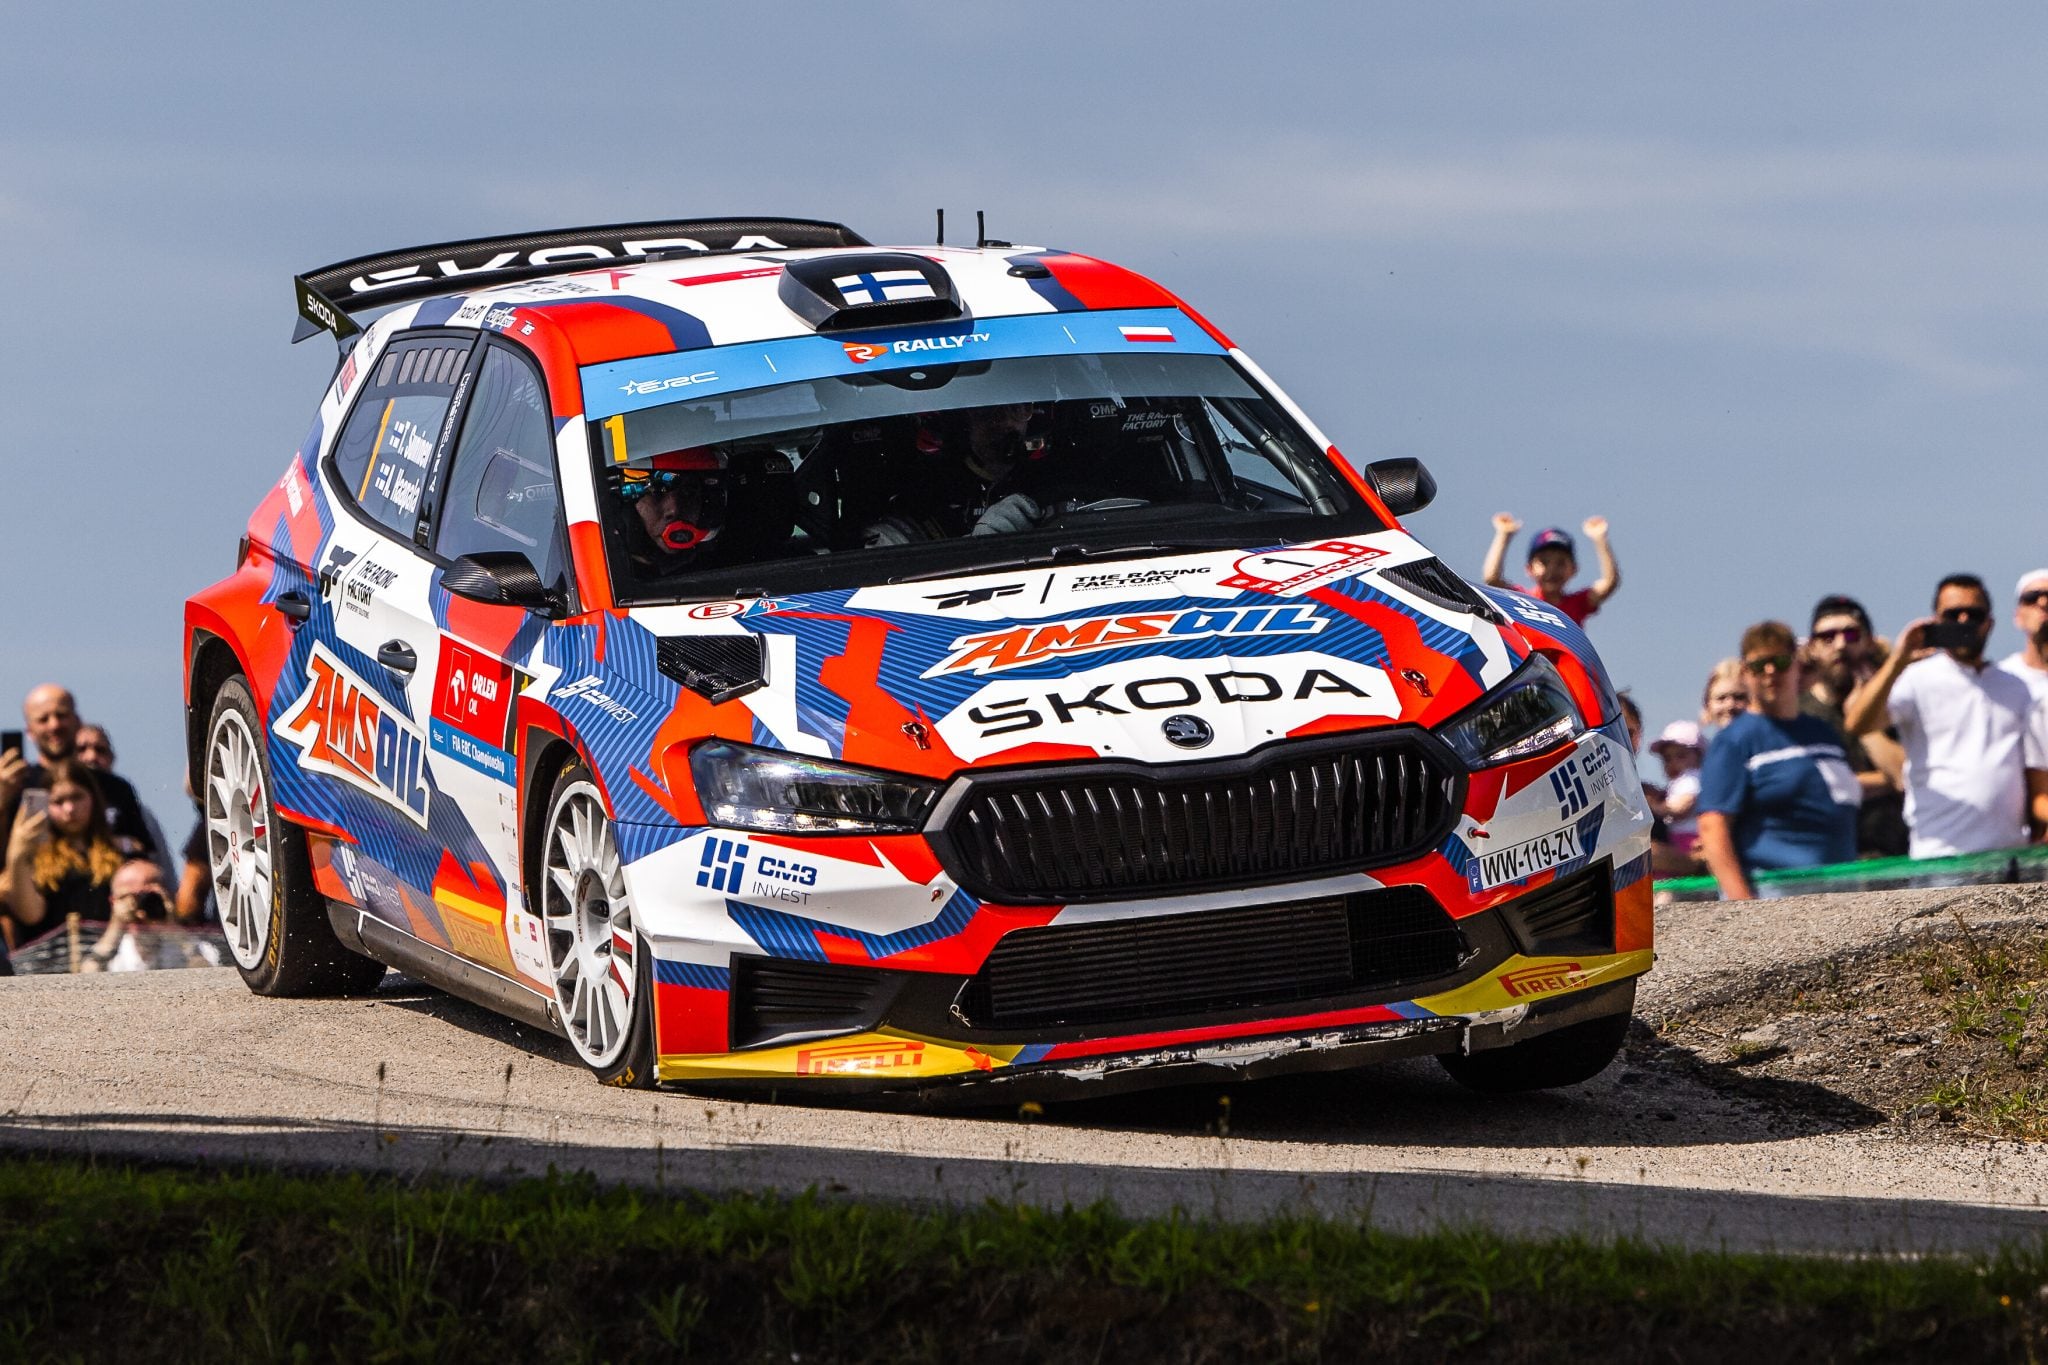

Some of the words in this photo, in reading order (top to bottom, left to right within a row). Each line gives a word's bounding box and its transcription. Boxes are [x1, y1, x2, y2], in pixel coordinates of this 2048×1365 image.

[307, 294, 338, 332] SKODA
[893, 335, 968, 353] RALLY
[637, 371, 719, 394] ERC
[1090, 404, 1117, 416] OMP
[1127, 413, 1146, 422] THE
[604, 414, 628, 463] 1
[1121, 419, 1167, 431] FACTORY
[357, 560, 378, 579] THE
[368, 566, 398, 589] RACING
[1075, 573, 1120, 583] THE
[1127, 567, 1211, 579] RACING
[1262, 557, 1315, 568] 1
[1268, 571, 1320, 592] RALLY
[1319, 551, 1381, 574] POLAND
[347, 579, 375, 606] FACTORY
[1071, 575, 1176, 589] FACTORY
[946, 606, 1324, 668] AMSOIL
[471, 672, 498, 702] ORLEN
[468, 698, 478, 716] OIL
[600, 699, 638, 724] INVEST
[968, 668, 1371, 738] SKODA
[288, 653, 426, 817] AMSOIL
[451, 734, 461, 753] FIA
[460, 738, 472, 758] ERC
[471, 744, 505, 777] Championship
[1582, 743, 1611, 776] CM3
[1590, 767, 1617, 796] INVEST
[758, 855, 818, 887] CM3
[1482, 827, 1577, 886] WW-119-ZY
[752, 881, 812, 906] INVEST
[1472, 877, 1479, 888] F
[440, 900, 505, 962] PIRELLI
[1497, 962, 1589, 999] PIRELLI
[796, 1041, 926, 1077] PIRELLI
